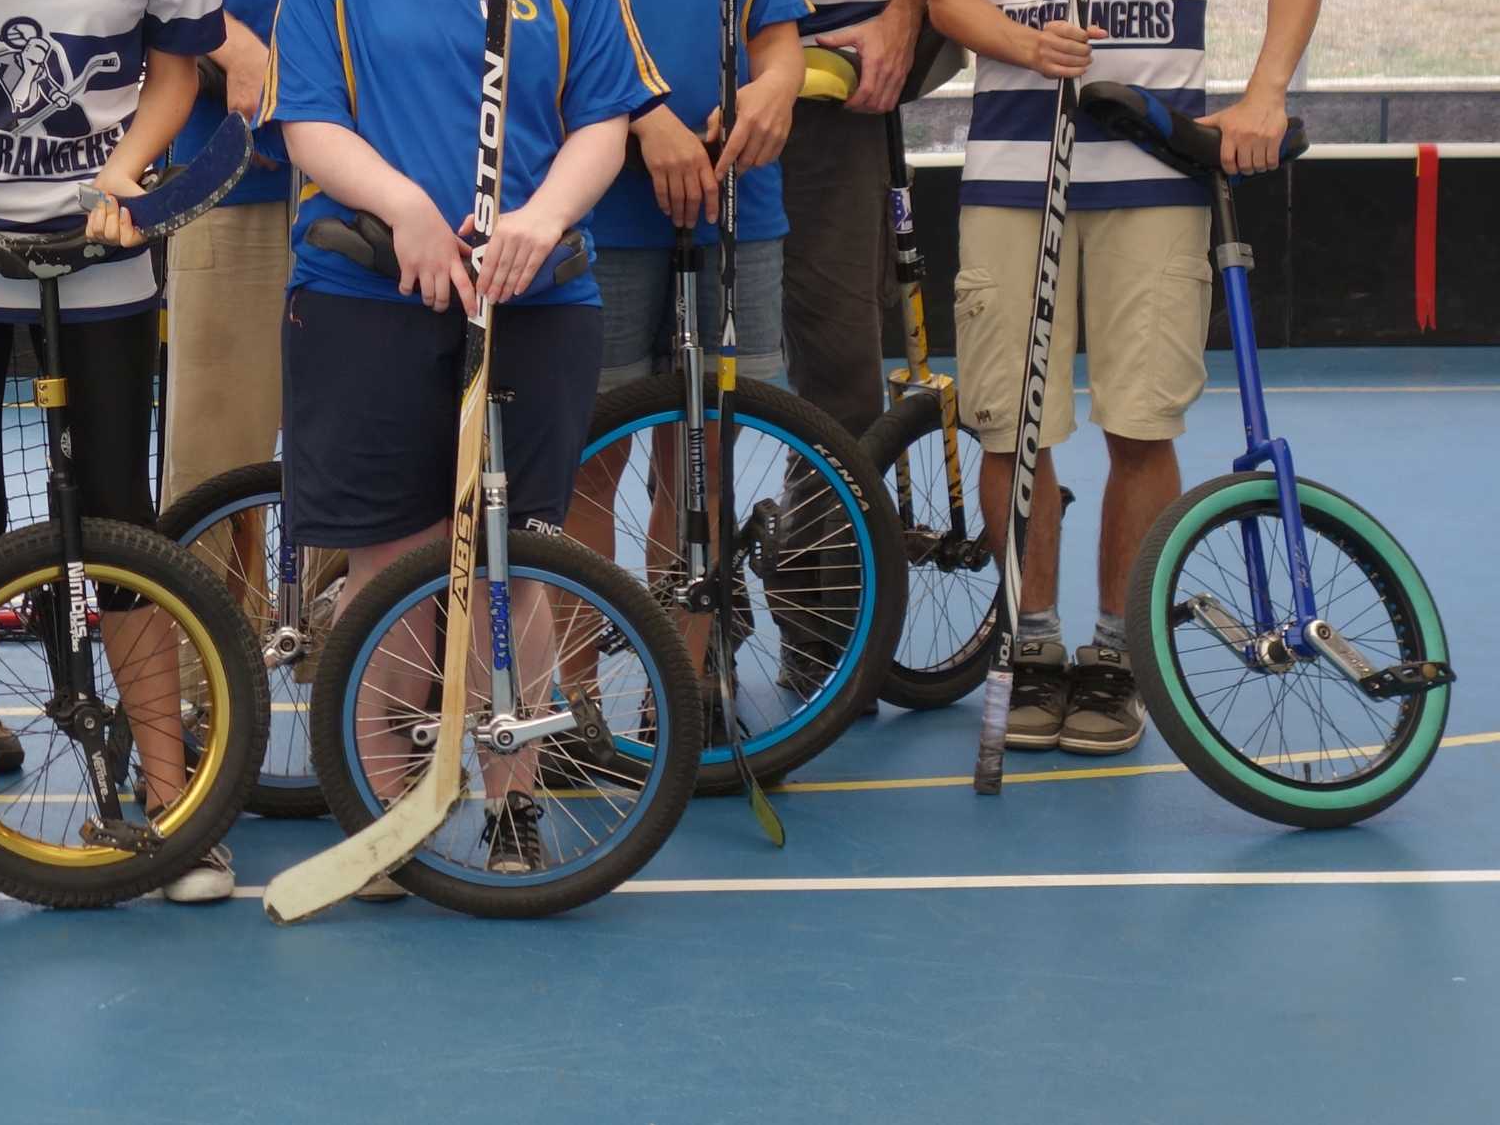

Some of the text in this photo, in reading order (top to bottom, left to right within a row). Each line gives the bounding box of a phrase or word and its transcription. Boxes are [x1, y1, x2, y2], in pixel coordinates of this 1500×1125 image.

[1015, 120, 1075, 519] SHER-WOOD
[813, 444, 870, 512] KENDA
[66, 561, 88, 639] Nimbus
[452, 508, 473, 617] ABS
